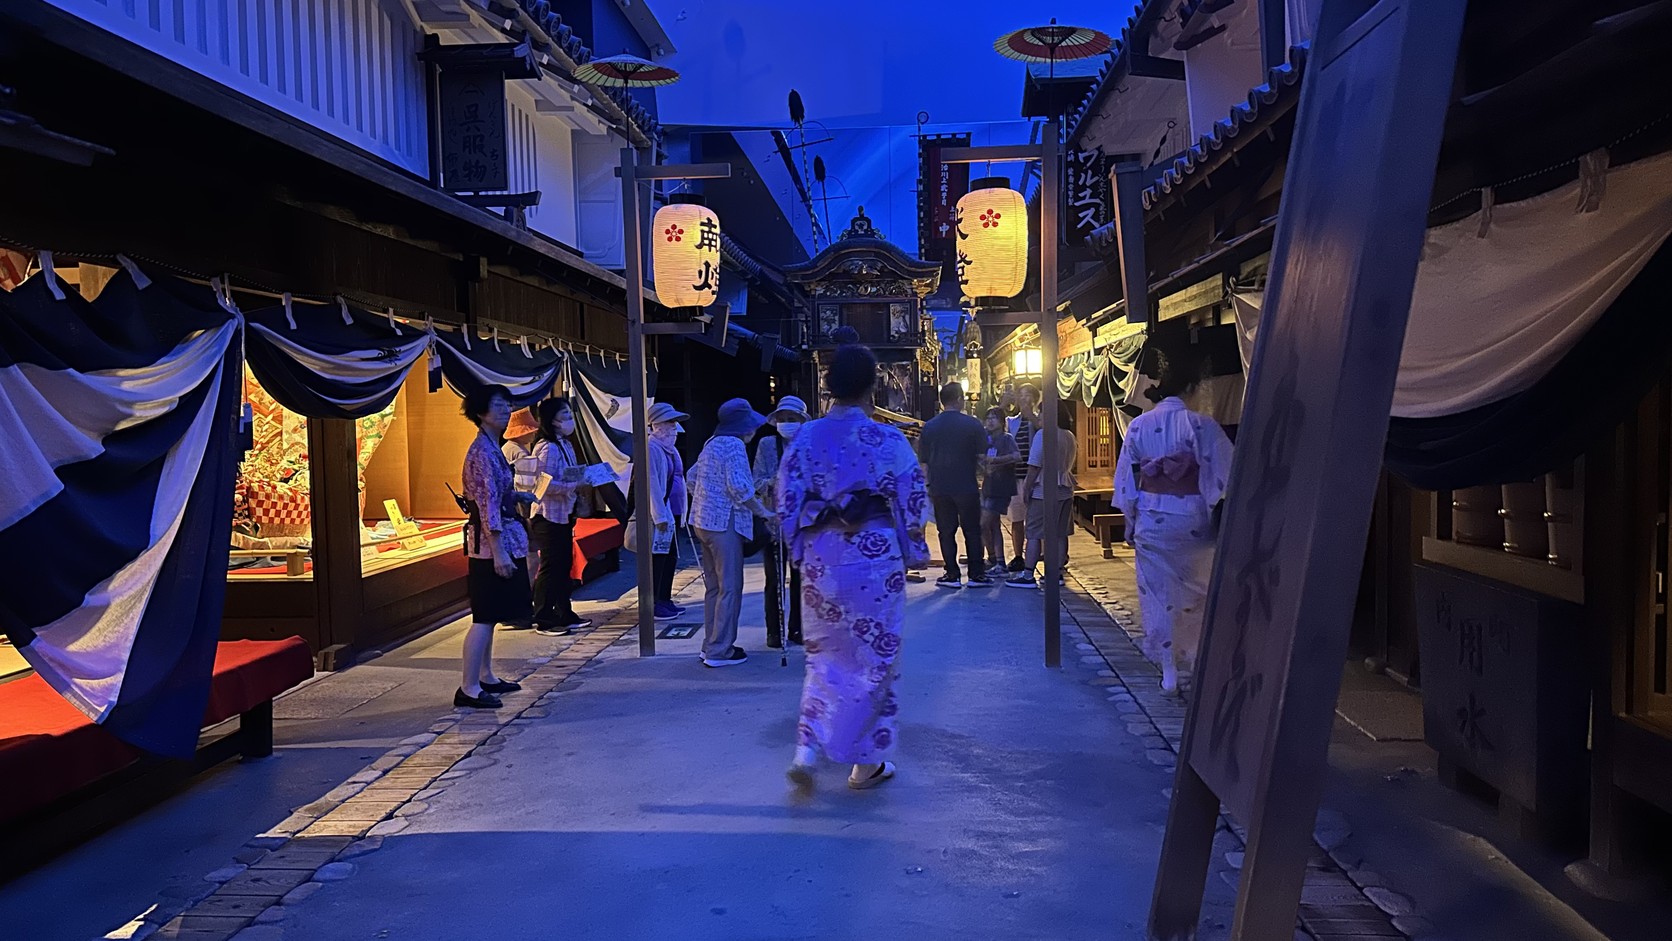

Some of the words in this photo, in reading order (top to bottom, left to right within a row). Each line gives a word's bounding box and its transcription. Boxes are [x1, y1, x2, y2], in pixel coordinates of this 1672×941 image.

[459, 103, 488, 183] 呉服物
[1457, 618, 1495, 751] 用水
